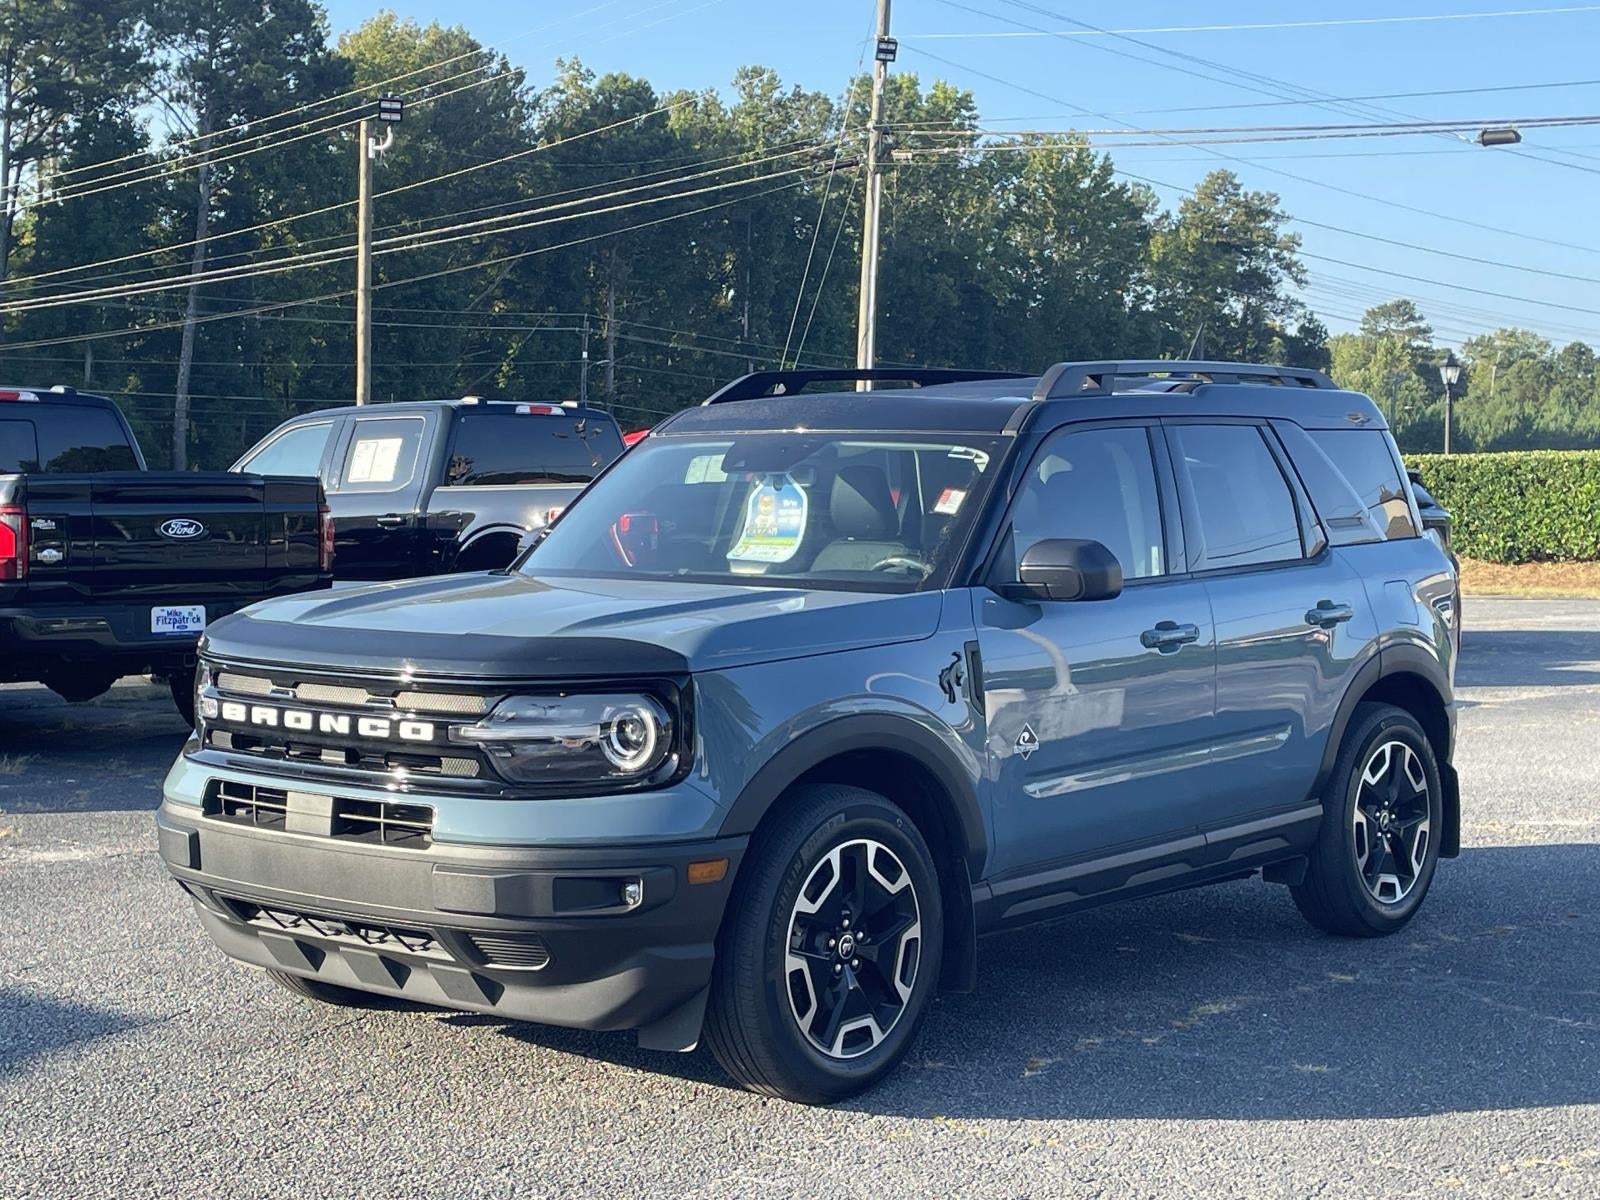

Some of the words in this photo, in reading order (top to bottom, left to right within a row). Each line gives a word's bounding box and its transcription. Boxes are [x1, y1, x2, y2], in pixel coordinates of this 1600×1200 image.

[168, 521, 197, 535] Ford
[166, 609, 182, 618] Mike
[221, 701, 435, 742] BRONCO
